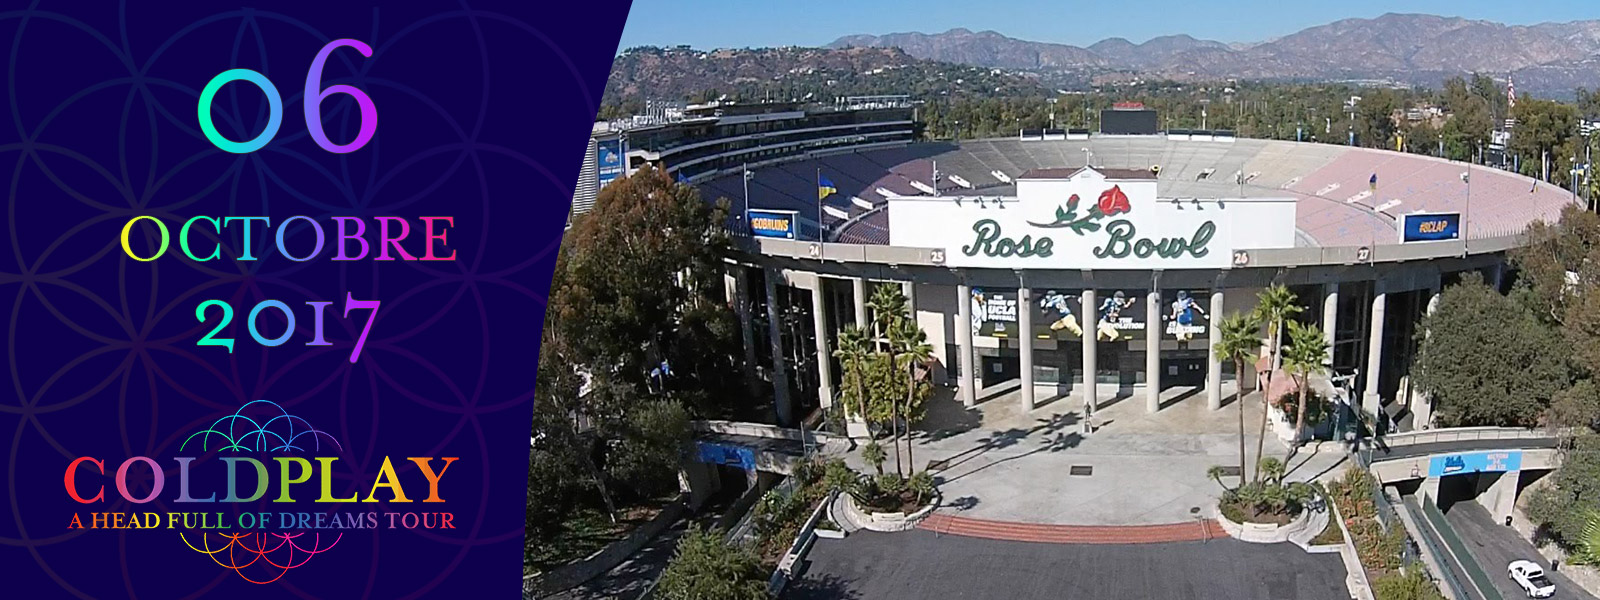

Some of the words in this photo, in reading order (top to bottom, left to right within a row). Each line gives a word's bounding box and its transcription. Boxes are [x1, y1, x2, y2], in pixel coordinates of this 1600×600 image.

[962, 218, 1054, 257] Rose
[1093, 218, 1216, 259] Bowl
[809, 245, 820, 256] 24
[1358, 249, 1370, 260] 27
[931, 251, 944, 262] 25
[1234, 252, 1248, 264] 26
[987, 305, 1017, 315] UCLA
